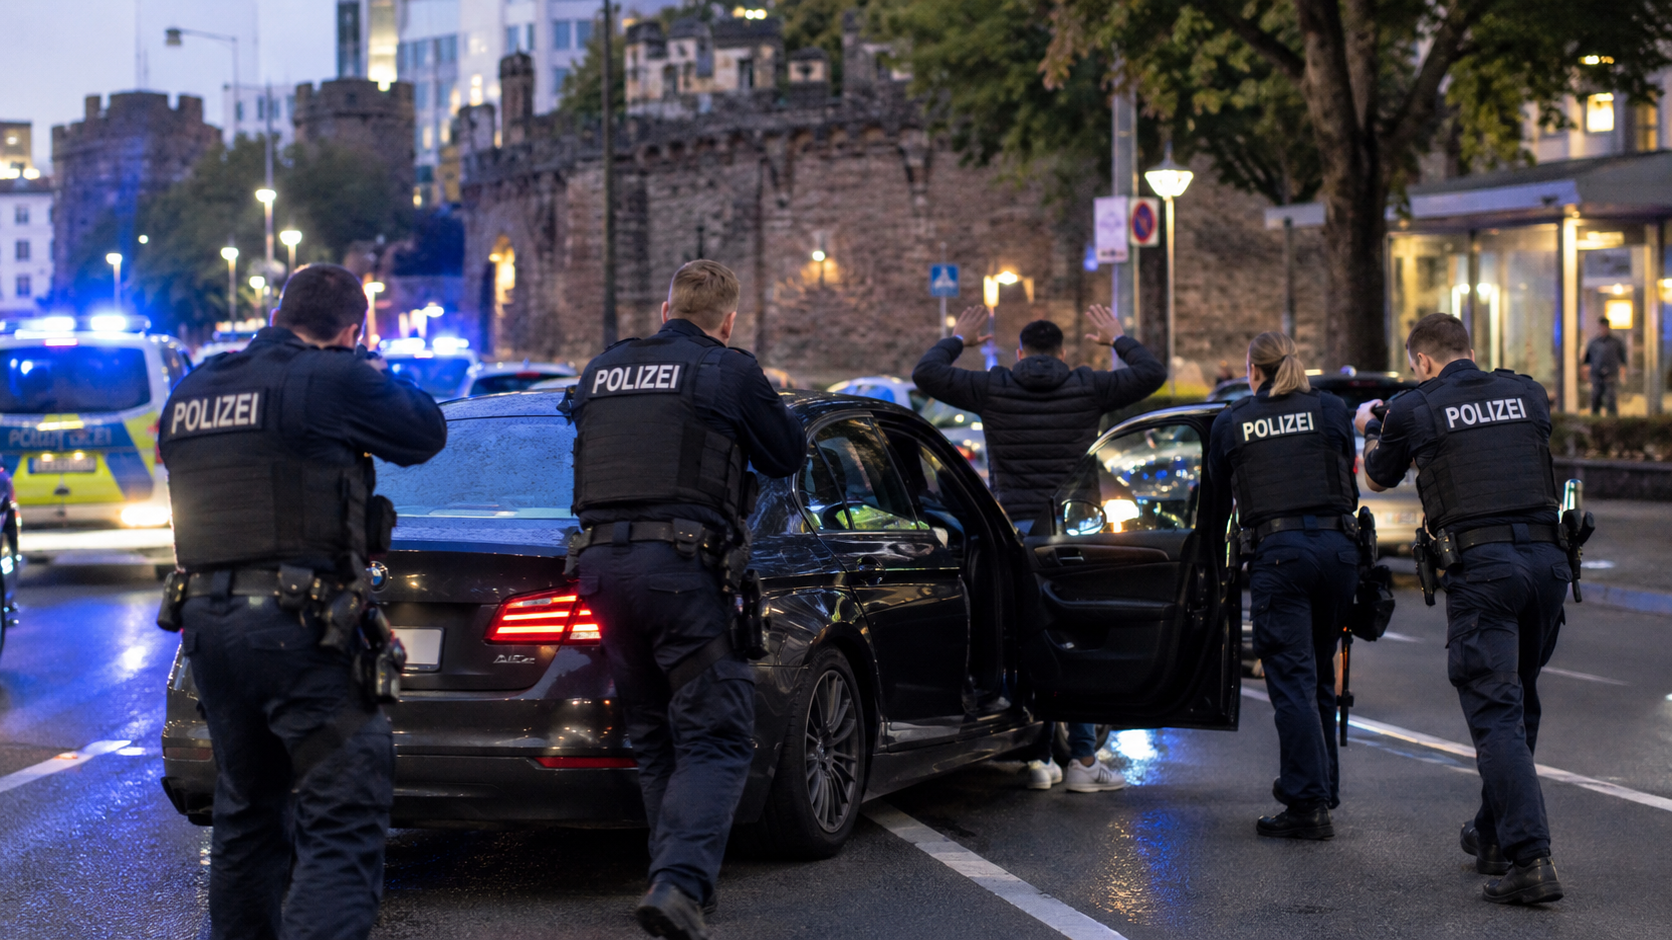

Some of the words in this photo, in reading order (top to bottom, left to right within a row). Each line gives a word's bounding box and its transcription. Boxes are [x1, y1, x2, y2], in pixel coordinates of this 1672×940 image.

[592, 365, 680, 394] POLIZEI
[171, 392, 259, 434] POLIZEI
[1242, 412, 1314, 441] POLIZEI
[1445, 398, 1527, 428] POLIZEI
